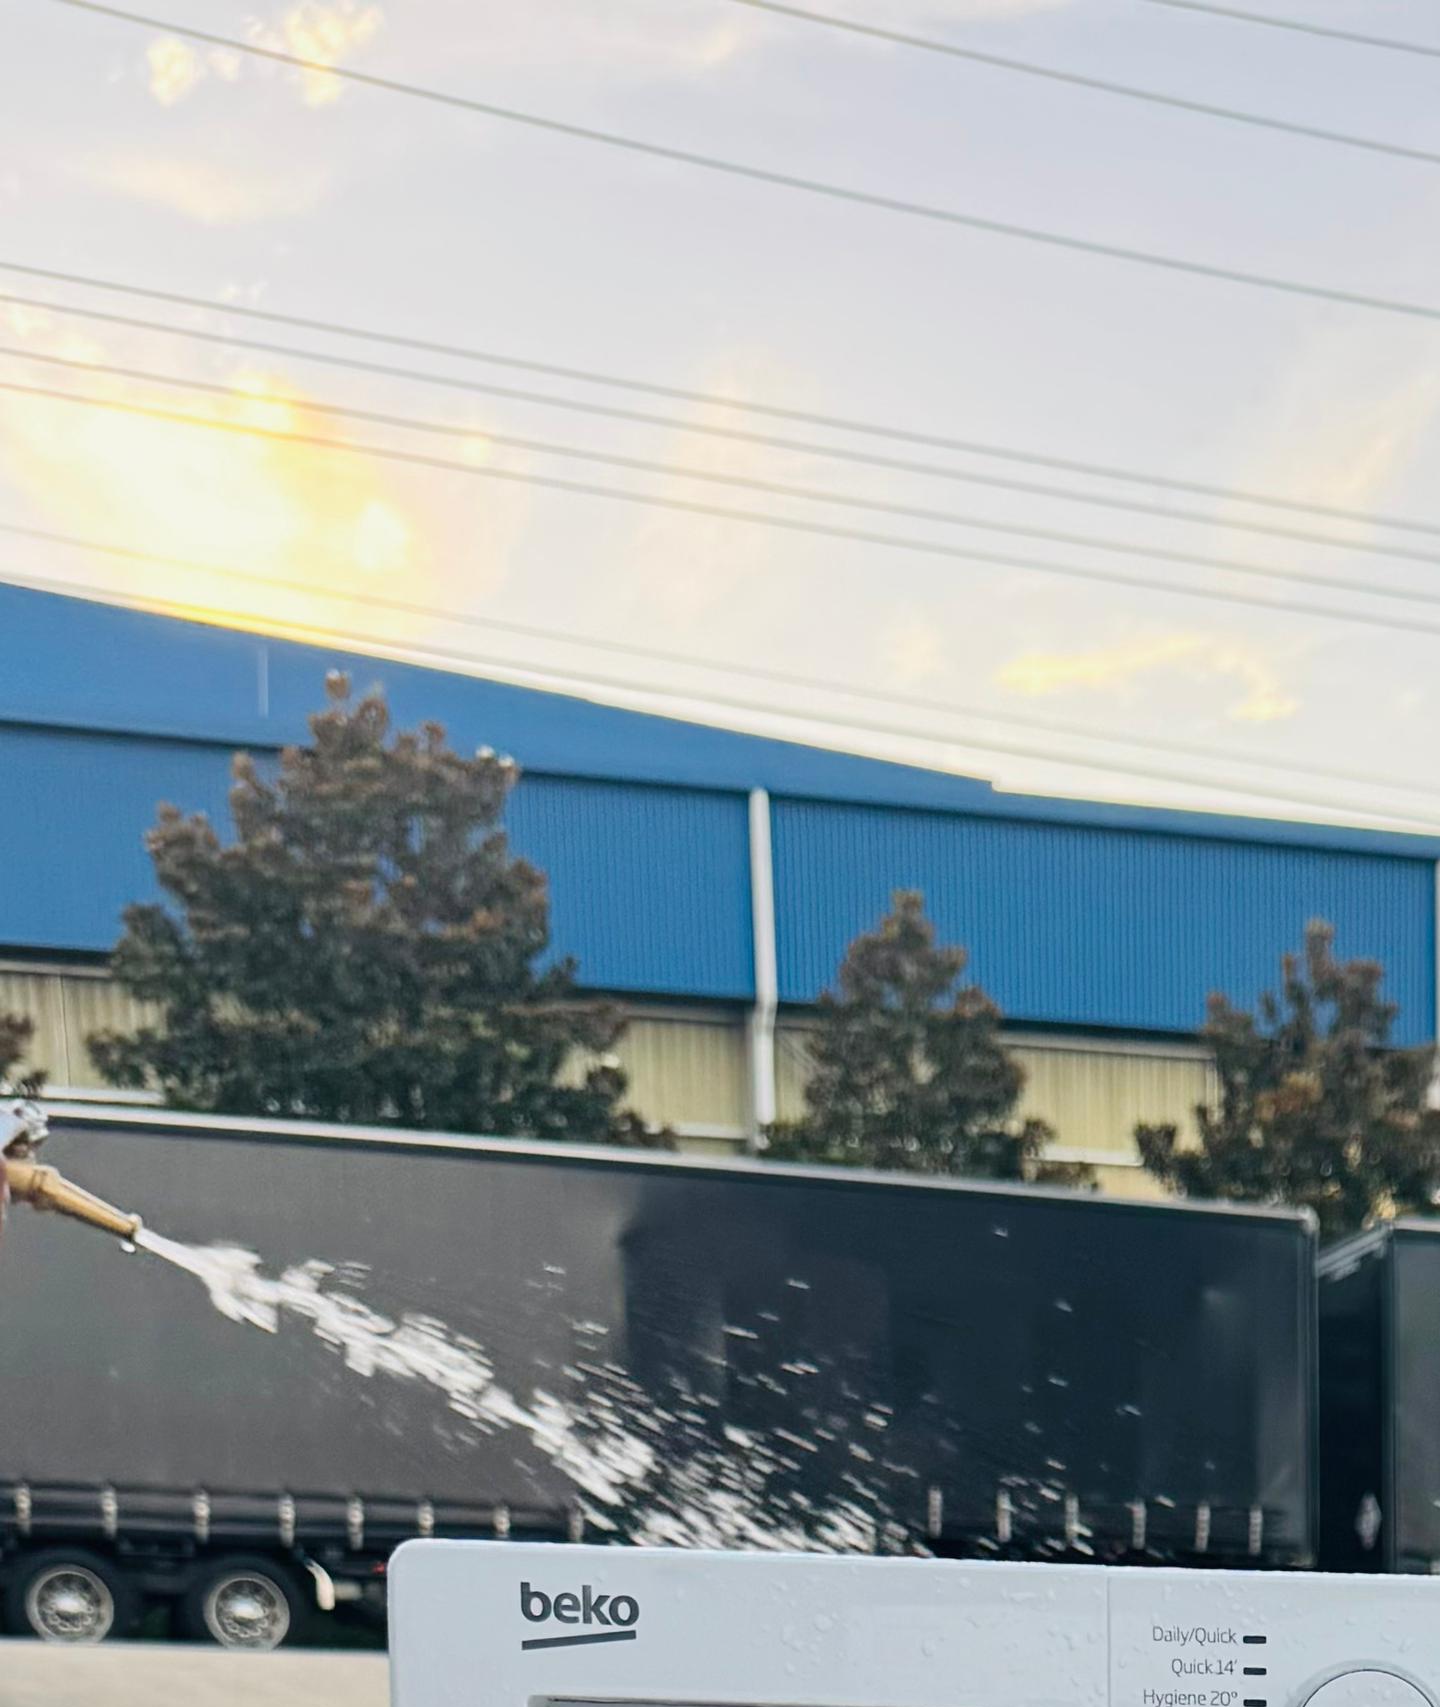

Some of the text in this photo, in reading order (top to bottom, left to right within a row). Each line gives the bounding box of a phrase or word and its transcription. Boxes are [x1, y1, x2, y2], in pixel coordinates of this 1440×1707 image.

[520, 1581, 640, 1626] beko
[1152, 1627, 1237, 1646] Daily/Quick
[1171, 1659, 1214, 1678] Quick
